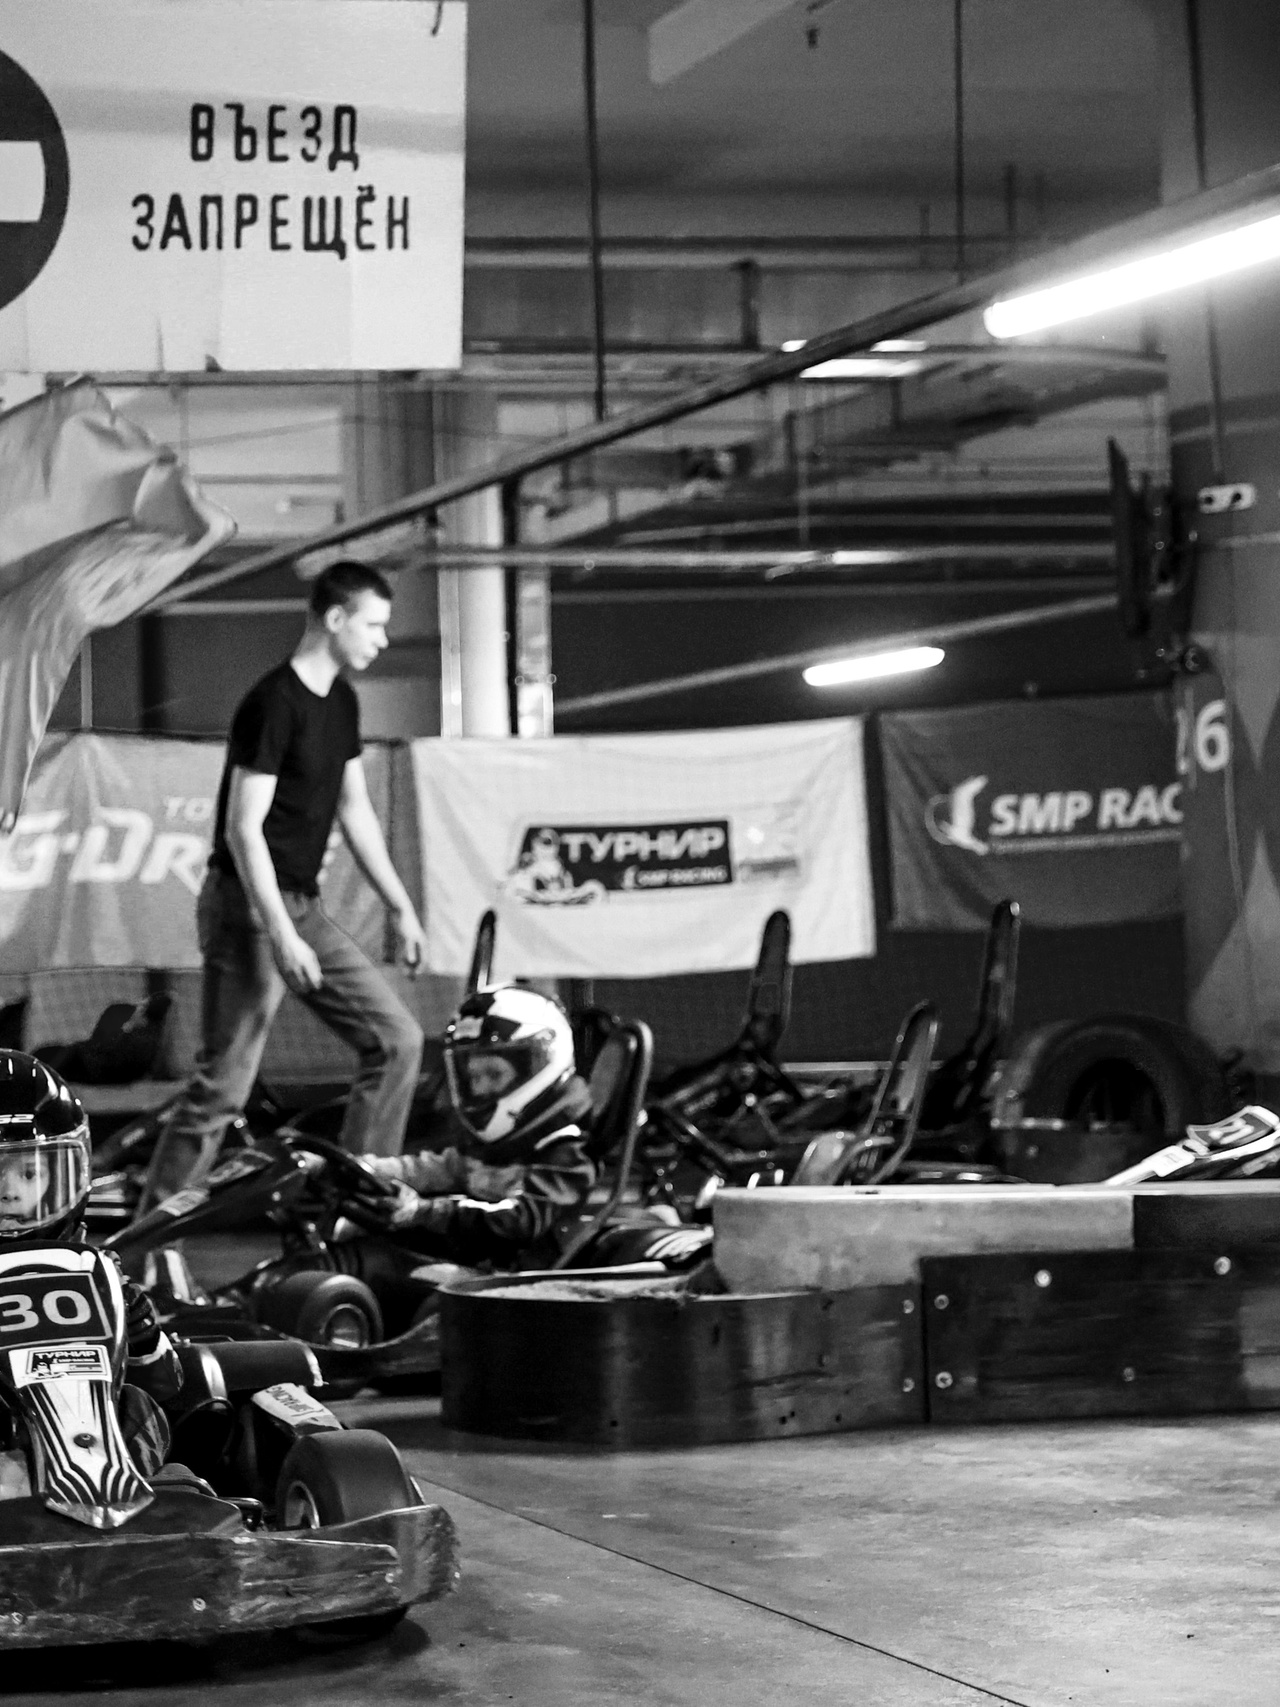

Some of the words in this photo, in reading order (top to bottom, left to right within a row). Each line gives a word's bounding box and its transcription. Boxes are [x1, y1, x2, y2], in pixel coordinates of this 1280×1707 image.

[189, 103, 360, 172] ВЪЕЗД
[131, 184, 410, 261] ЗАПРЕЩЁН
[163, 797, 214, 821] TO
[989, 790, 1093, 837] SMP
[1097, 783, 1184, 830] RAC
[561, 826, 725, 863] ТУРНИР
